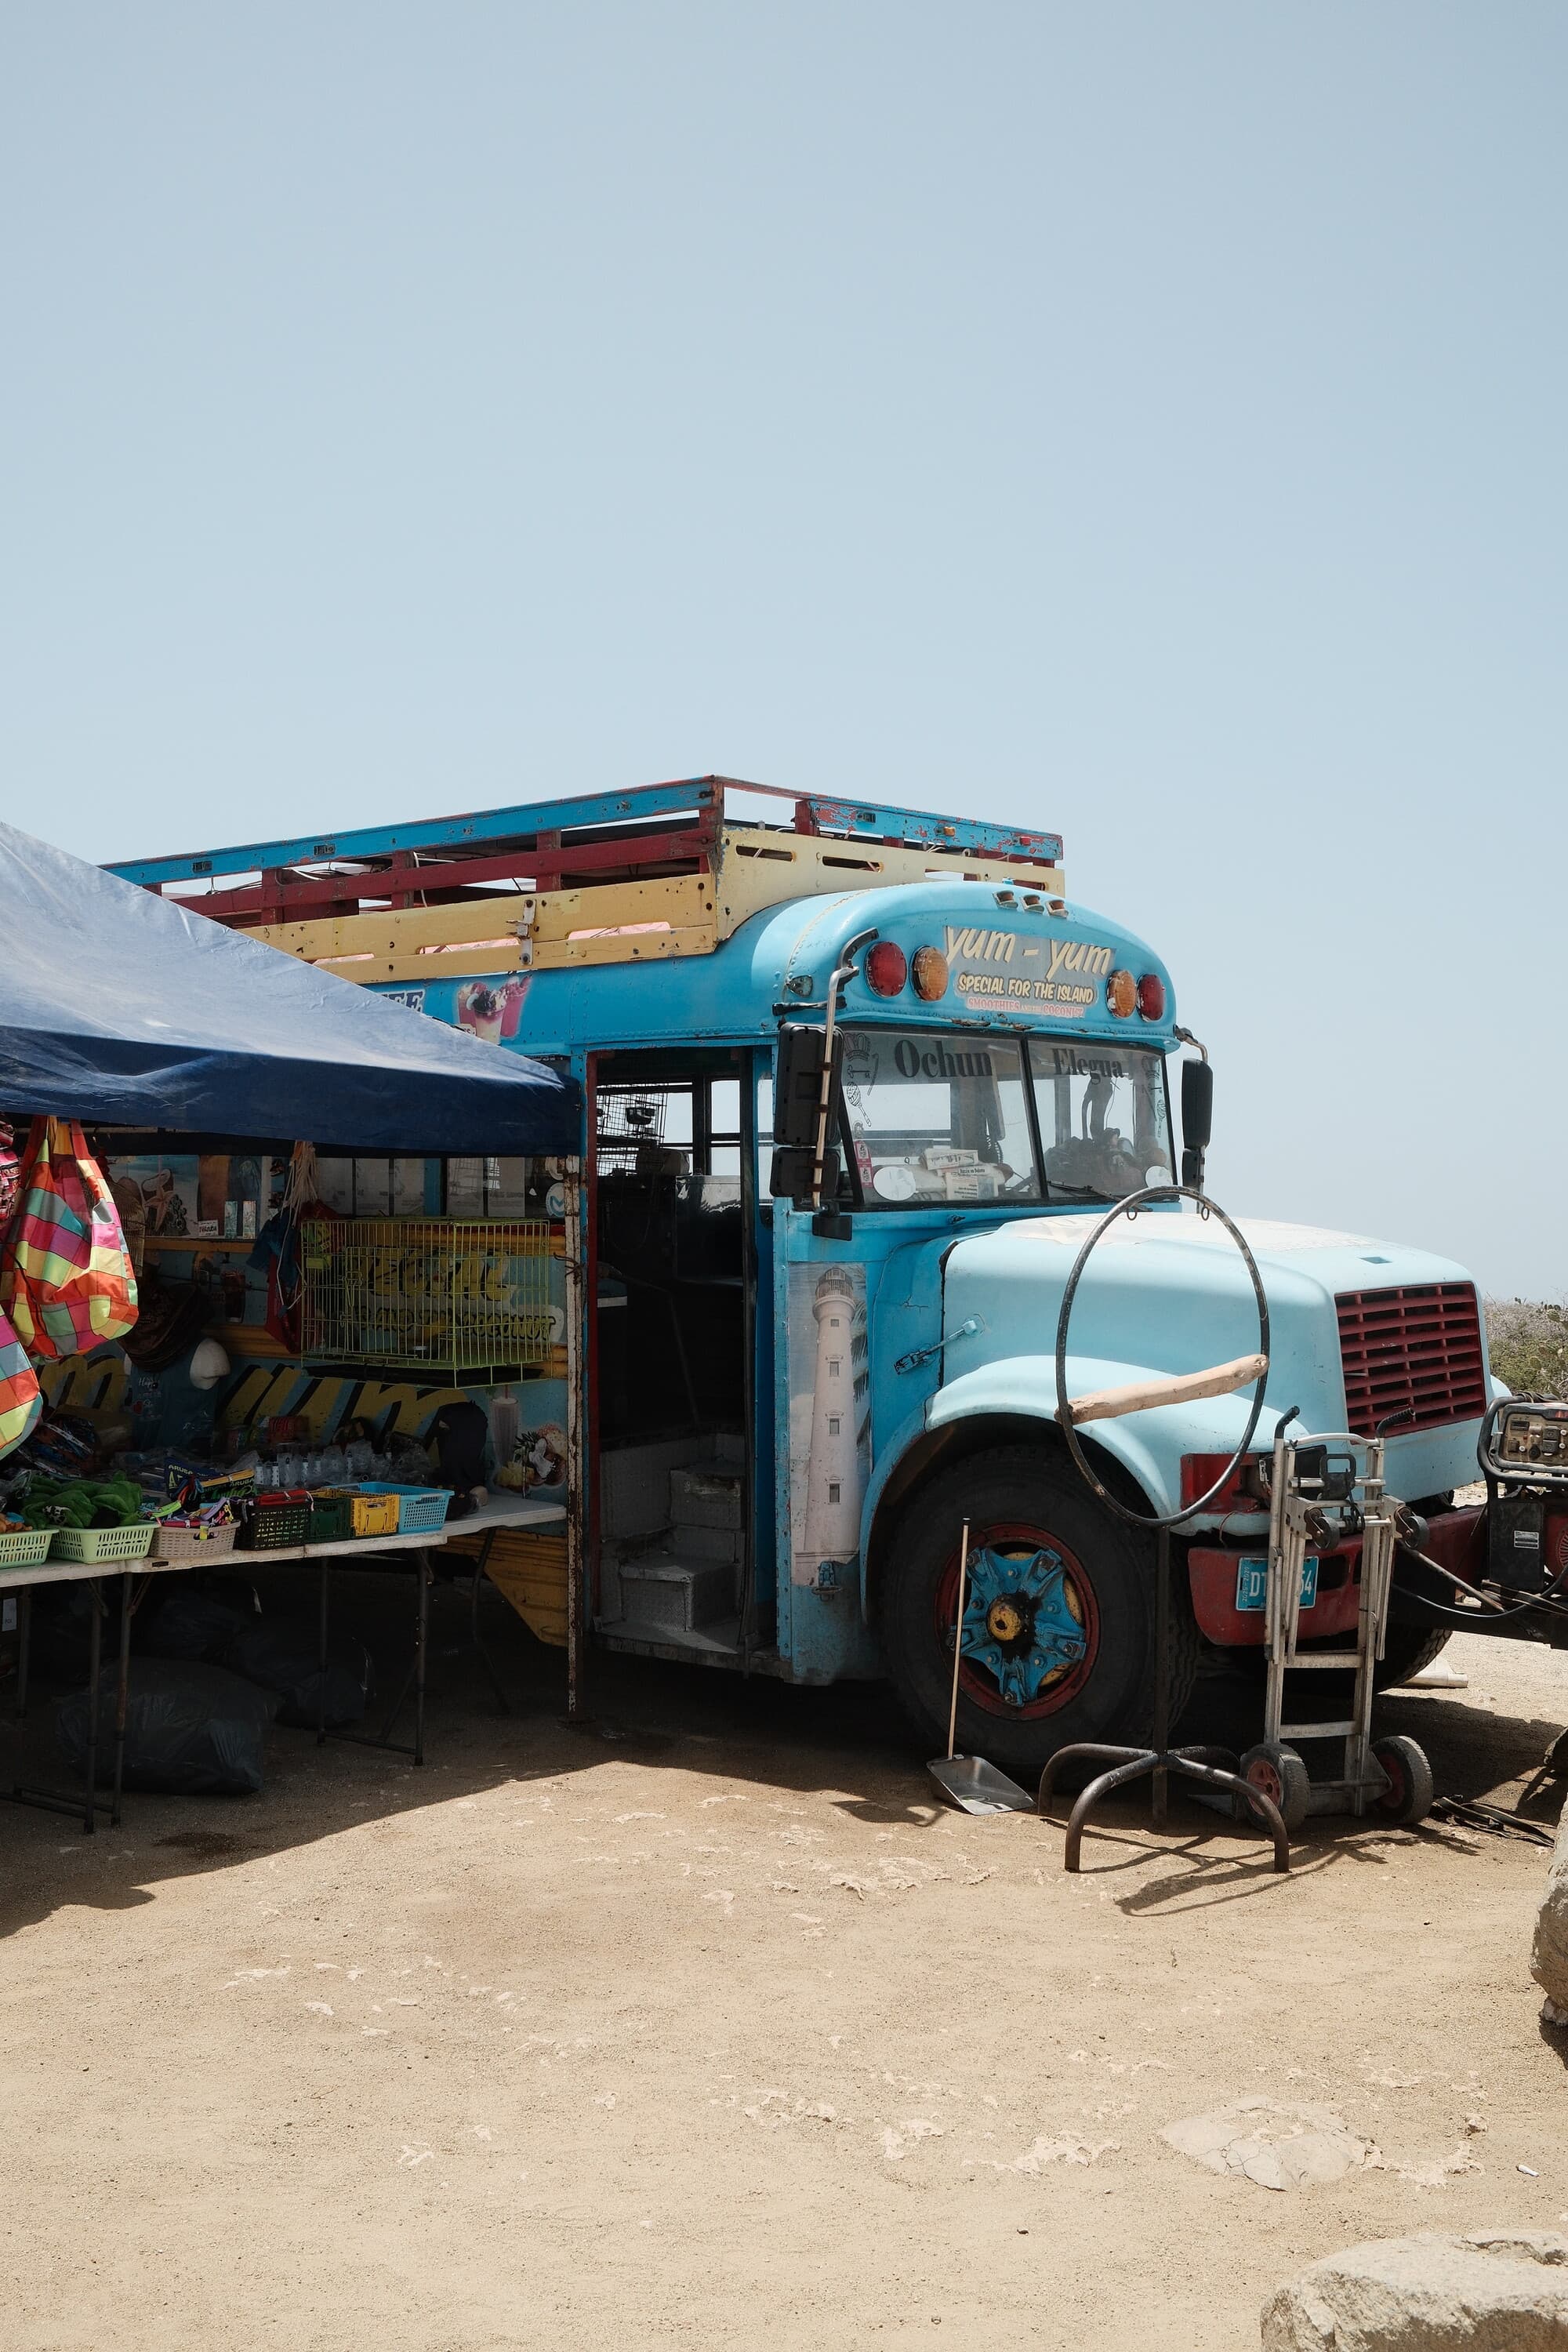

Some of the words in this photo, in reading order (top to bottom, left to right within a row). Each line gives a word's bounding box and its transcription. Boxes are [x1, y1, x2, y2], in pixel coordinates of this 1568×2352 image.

[946, 926, 1016, 966] yum
[1045, 938, 1112, 981] yum
[958, 974, 1005, 996] SPECIAL
[1007, 977, 1031, 997] FOR
[1033, 980, 1055, 1000] THE
[1056, 984, 1094, 1004] ISLAND
[968, 997, 1020, 1011] SMOOTHIES
[1043, 1004, 1083, 1017] COCONUT
[894, 1039, 993, 1078] Ochun
[1052, 1048, 1125, 1085] Elegua
